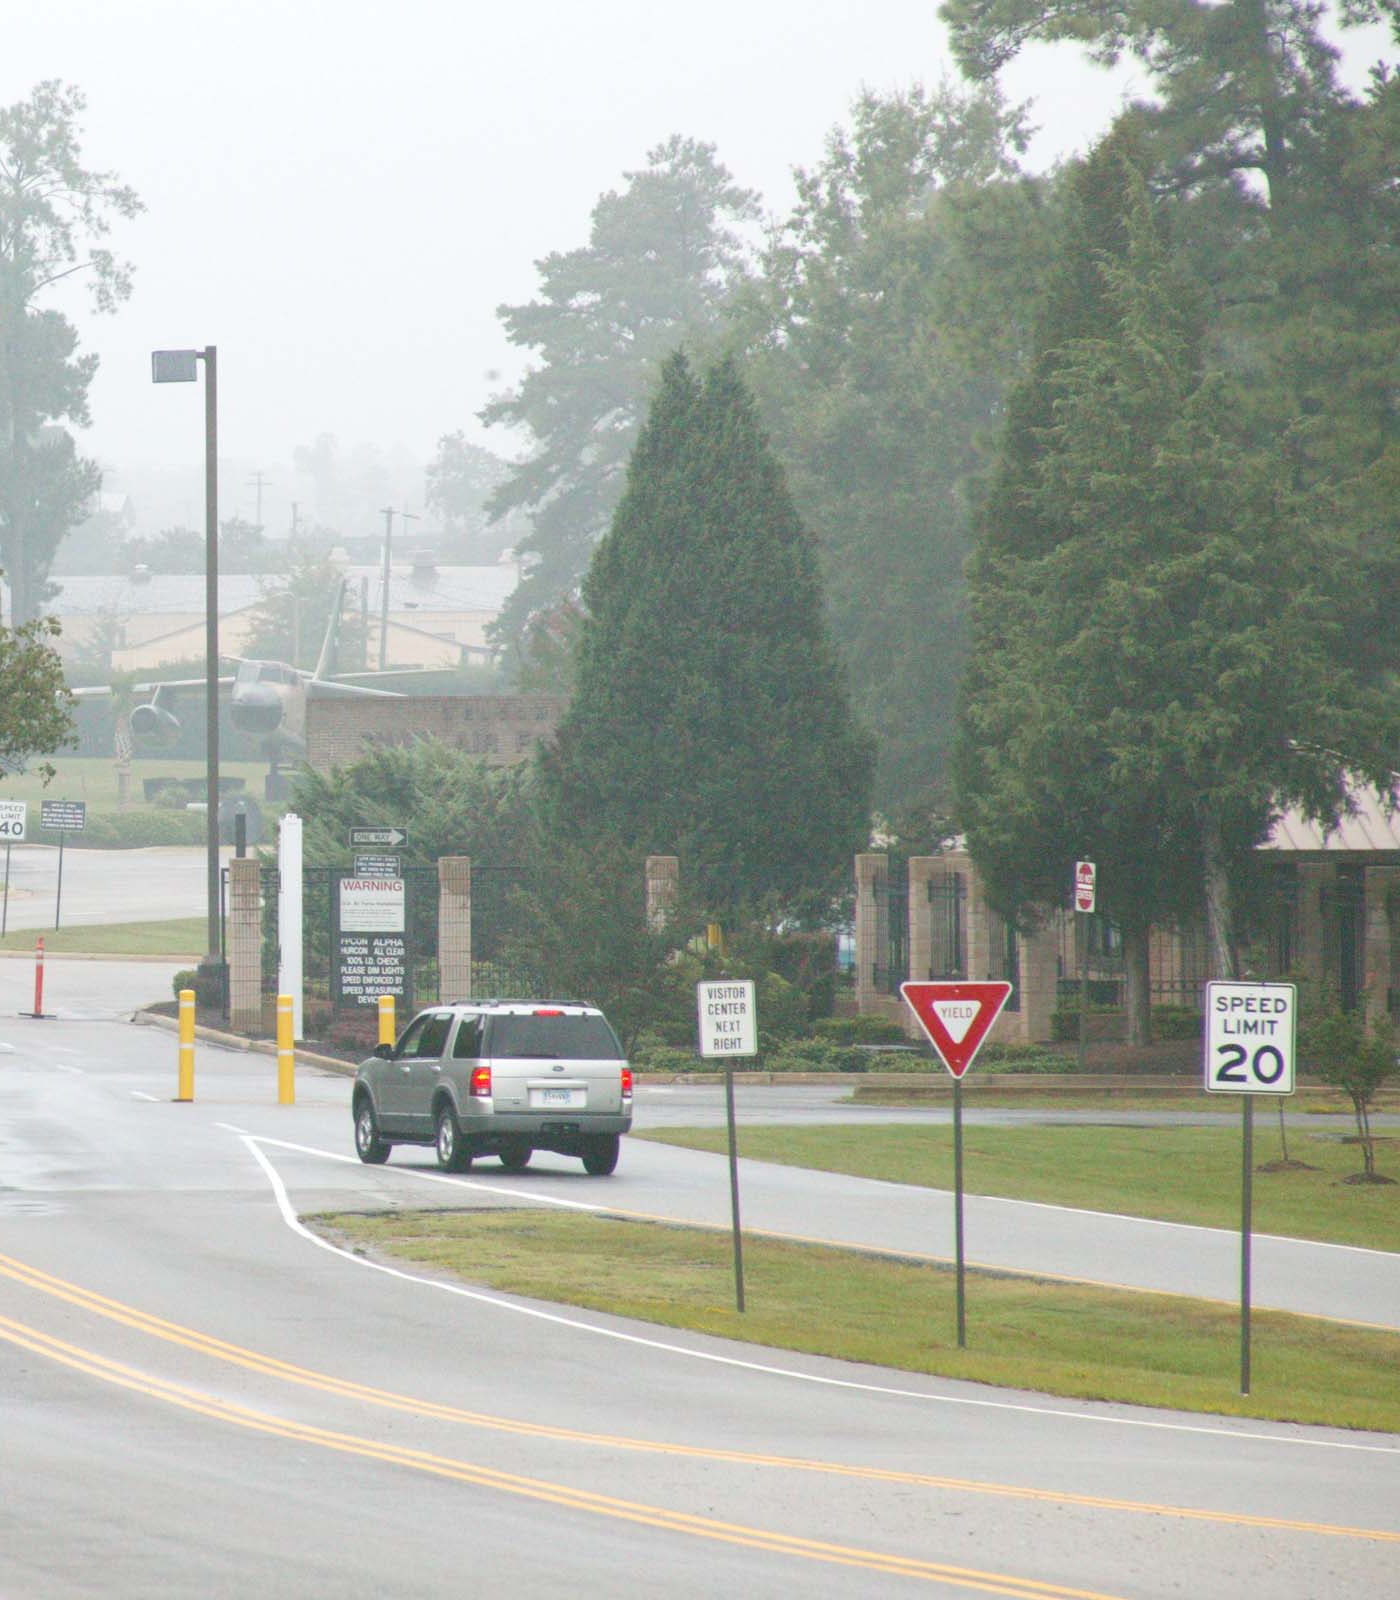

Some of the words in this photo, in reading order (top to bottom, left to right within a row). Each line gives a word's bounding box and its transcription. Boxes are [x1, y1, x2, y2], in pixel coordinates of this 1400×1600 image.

[356, 832, 370, 841] ONE
[375, 832, 390, 841] WAY
[343, 881, 402, 891] WARNING
[373, 938, 404, 946] ALPHA
[341, 966, 366, 974] PLEASE
[381, 966, 405, 975] LIGHTS
[342, 986, 363, 994] SPEED
[365, 986, 404, 995] MEASURING
[707, 987, 745, 999] VISITOR
[708, 1003, 746, 1015] CENTER
[1216, 996, 1287, 1013] SPEED
[941, 1008, 973, 1018] YIELD
[716, 1020, 741, 1032] NEXT
[1223, 1019, 1278, 1035] LIMIT
[713, 1038, 743, 1050] RIGHT
[1216, 1044, 1285, 1084] 20
